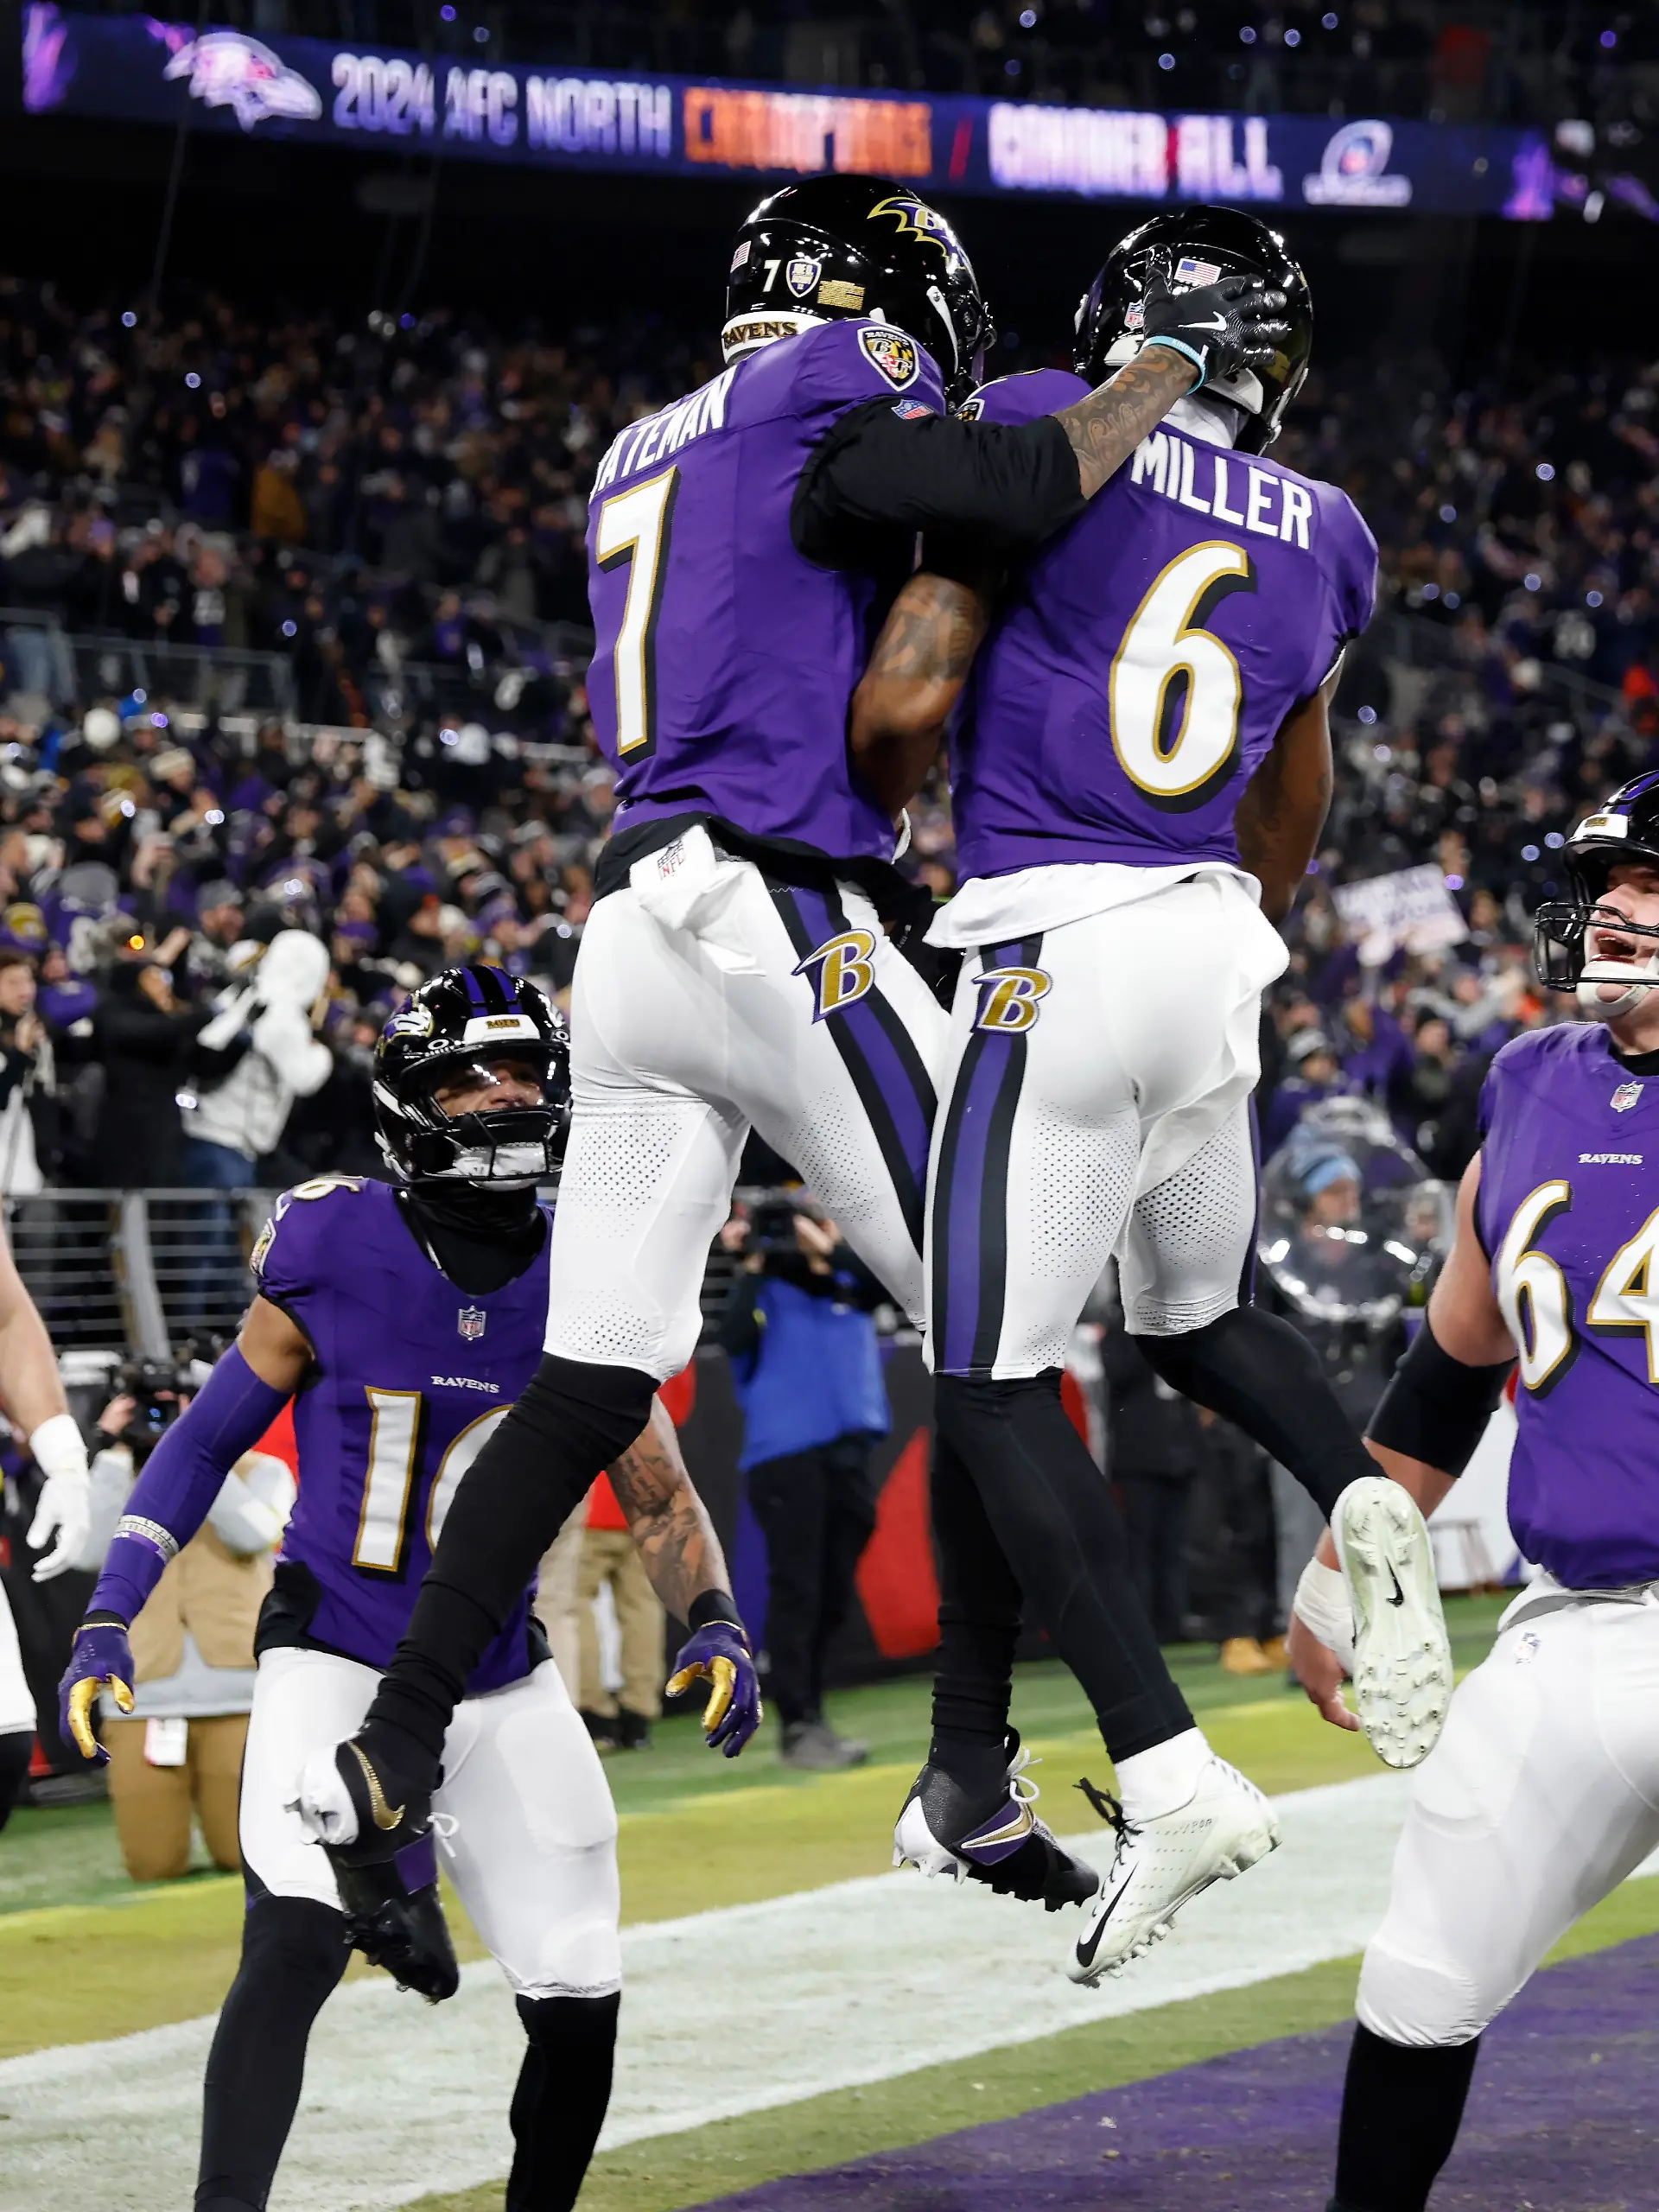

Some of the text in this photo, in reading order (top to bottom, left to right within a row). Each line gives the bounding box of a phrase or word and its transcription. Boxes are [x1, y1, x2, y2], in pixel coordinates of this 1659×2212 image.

[332, 52, 436, 137] 2024
[443, 66, 518, 146] AFC
[526, 74, 671, 158] NORTH
[762, 259, 781, 292] 7
[1130, 431, 1313, 550] MILLER
[597, 467, 680, 764] 7
[1109, 539, 1255, 813] 6
[663, 853, 684, 878] NFL
[1578, 1153, 1643, 1165] RAVENS
[1497, 1179, 1659, 1399] 64
[431, 1376, 500, 1394] RAVENS
